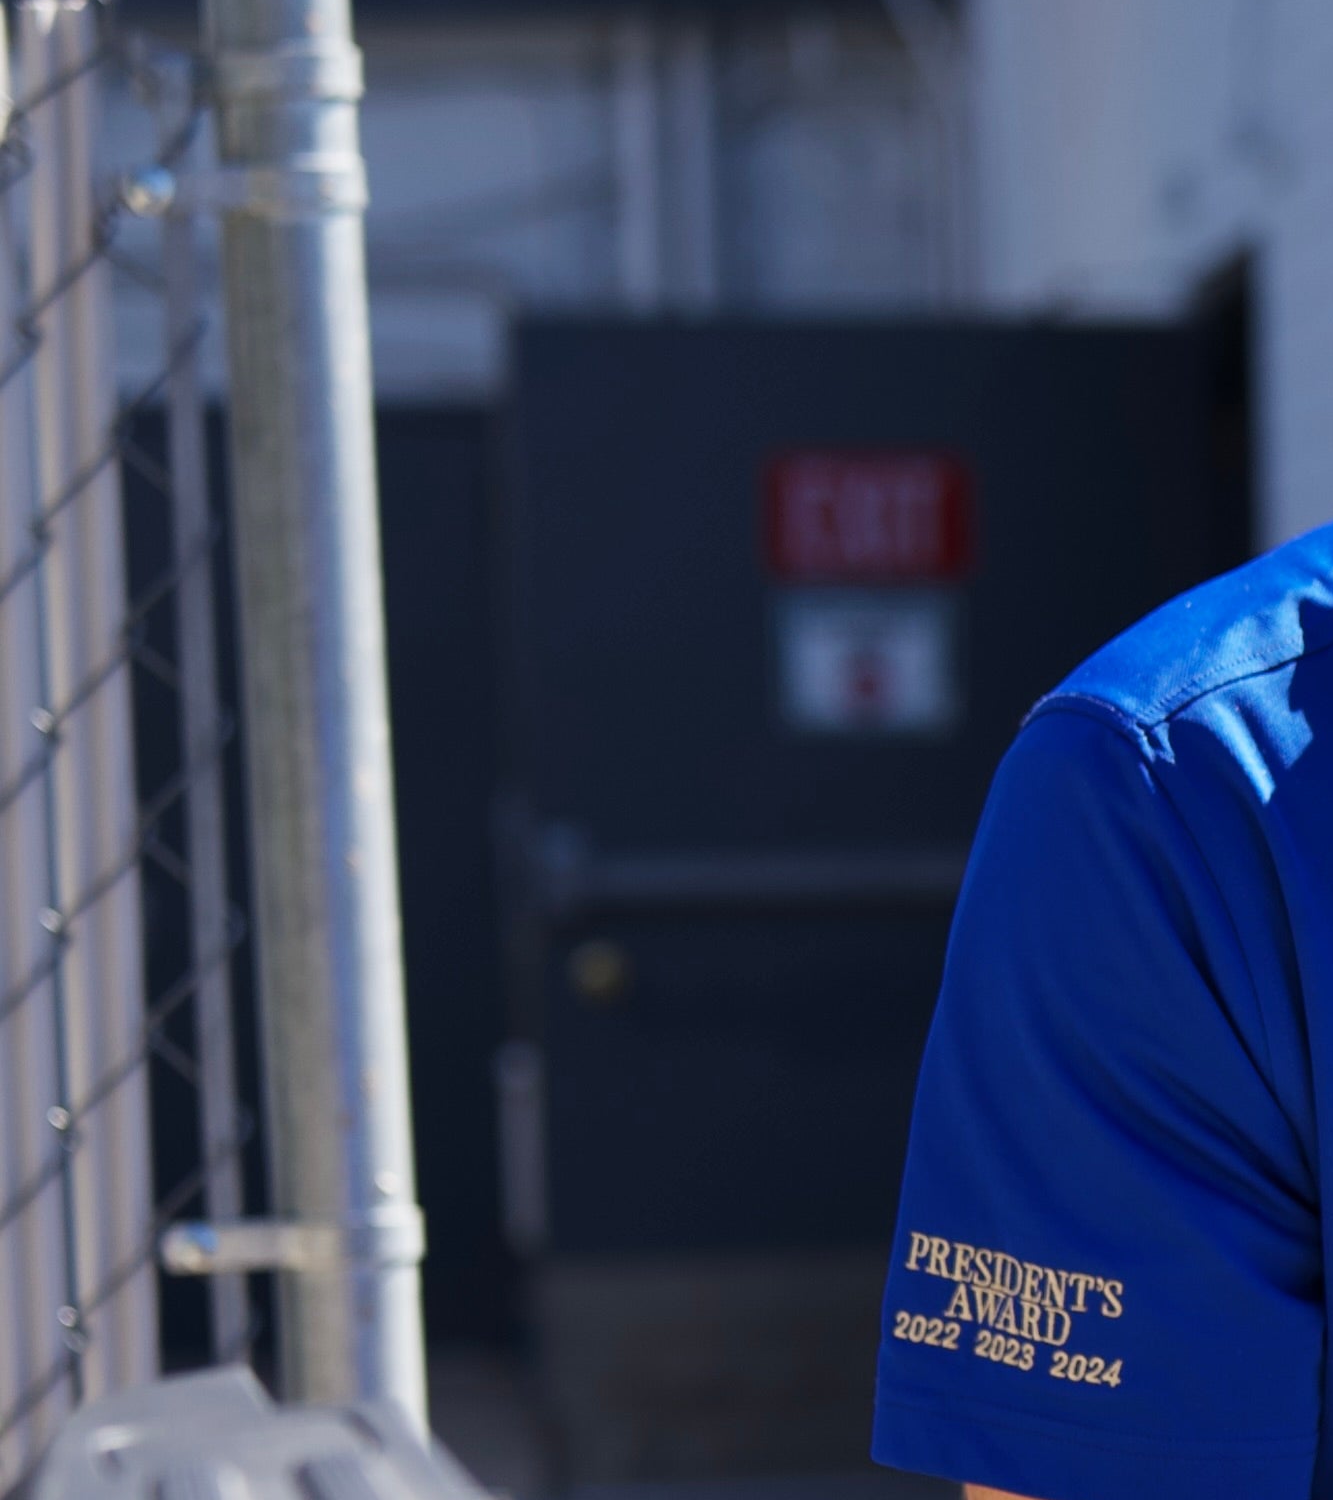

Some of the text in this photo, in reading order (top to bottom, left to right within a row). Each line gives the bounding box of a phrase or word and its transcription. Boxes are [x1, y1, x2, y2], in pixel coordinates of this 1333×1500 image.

[905, 1231, 1124, 1318] PRESIDENT'S
[893, 1311, 1123, 1388] 2022 2023 2024
[944, 1283, 1071, 1346] AWARD
